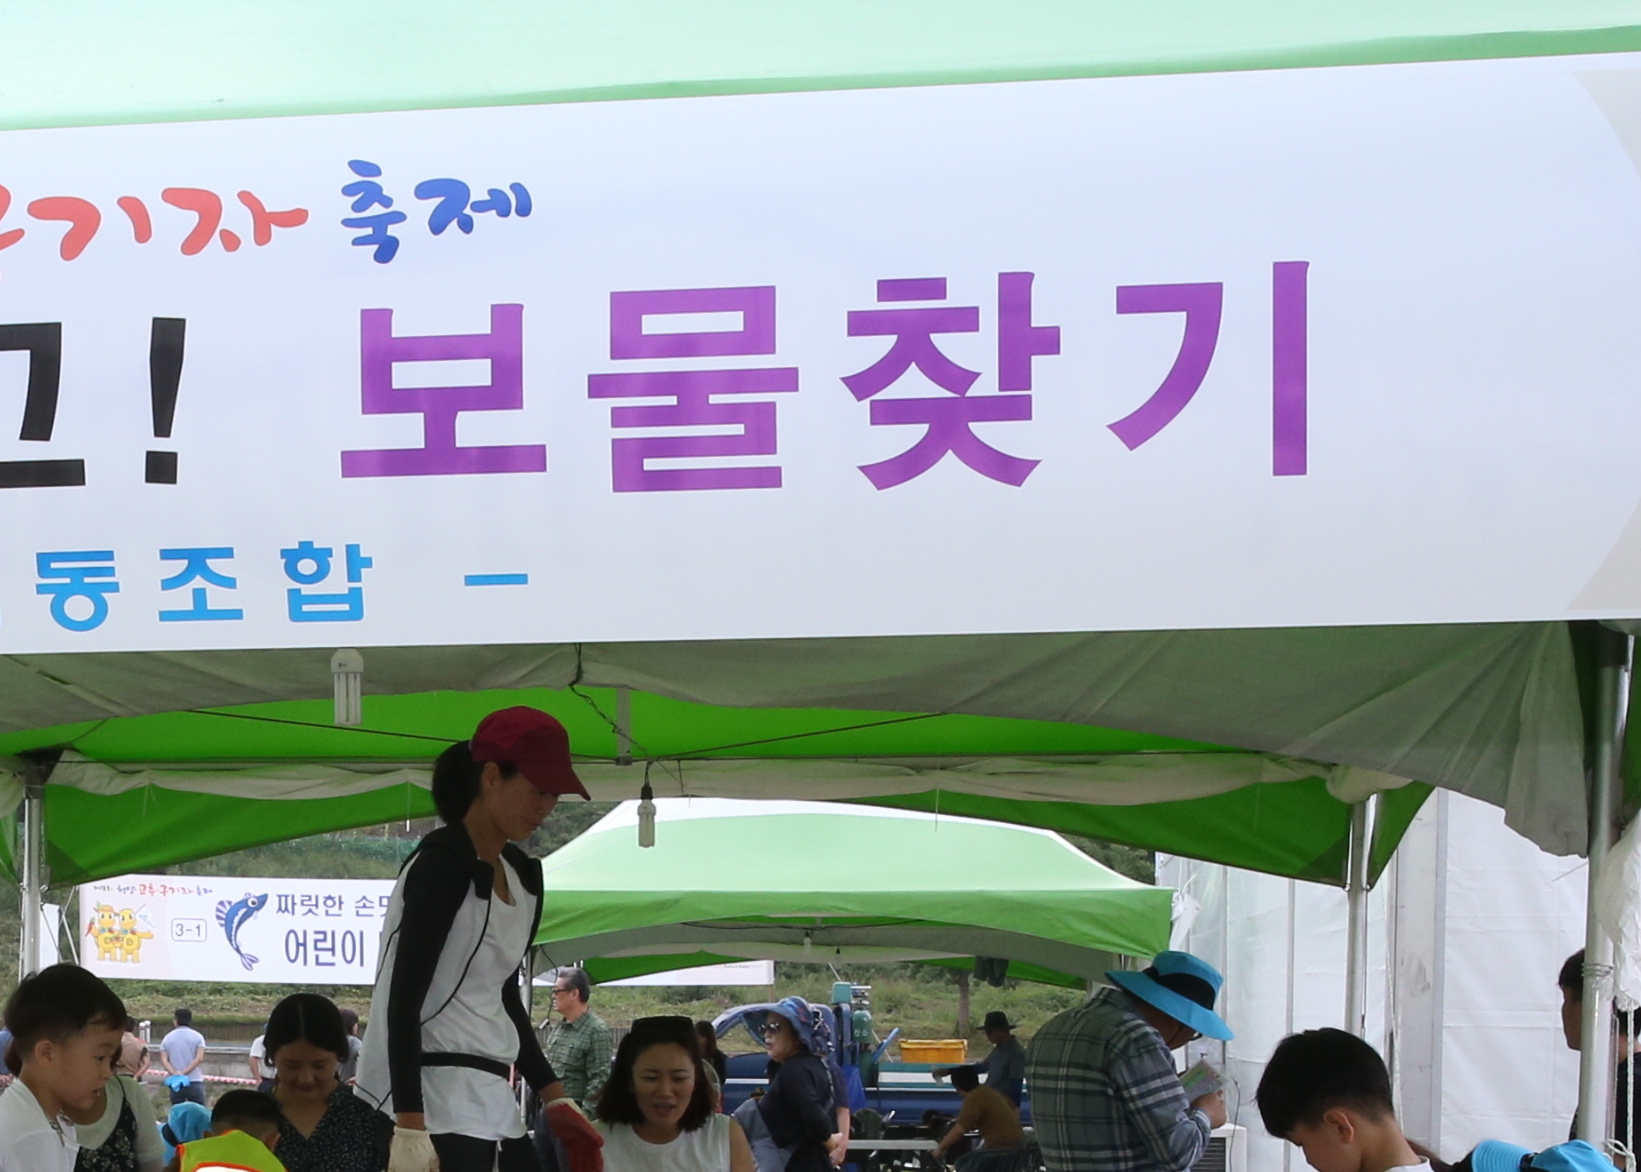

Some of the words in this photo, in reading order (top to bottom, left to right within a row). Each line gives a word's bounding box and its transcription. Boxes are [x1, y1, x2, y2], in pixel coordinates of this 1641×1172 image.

[342, 160, 532, 263] 축제
[341, 261, 1309, 492] 보물찾기
[276, 893, 344, 917] 짜릿한
[175, 925, 202, 938] 3-1
[285, 928, 365, 968] 어린이
